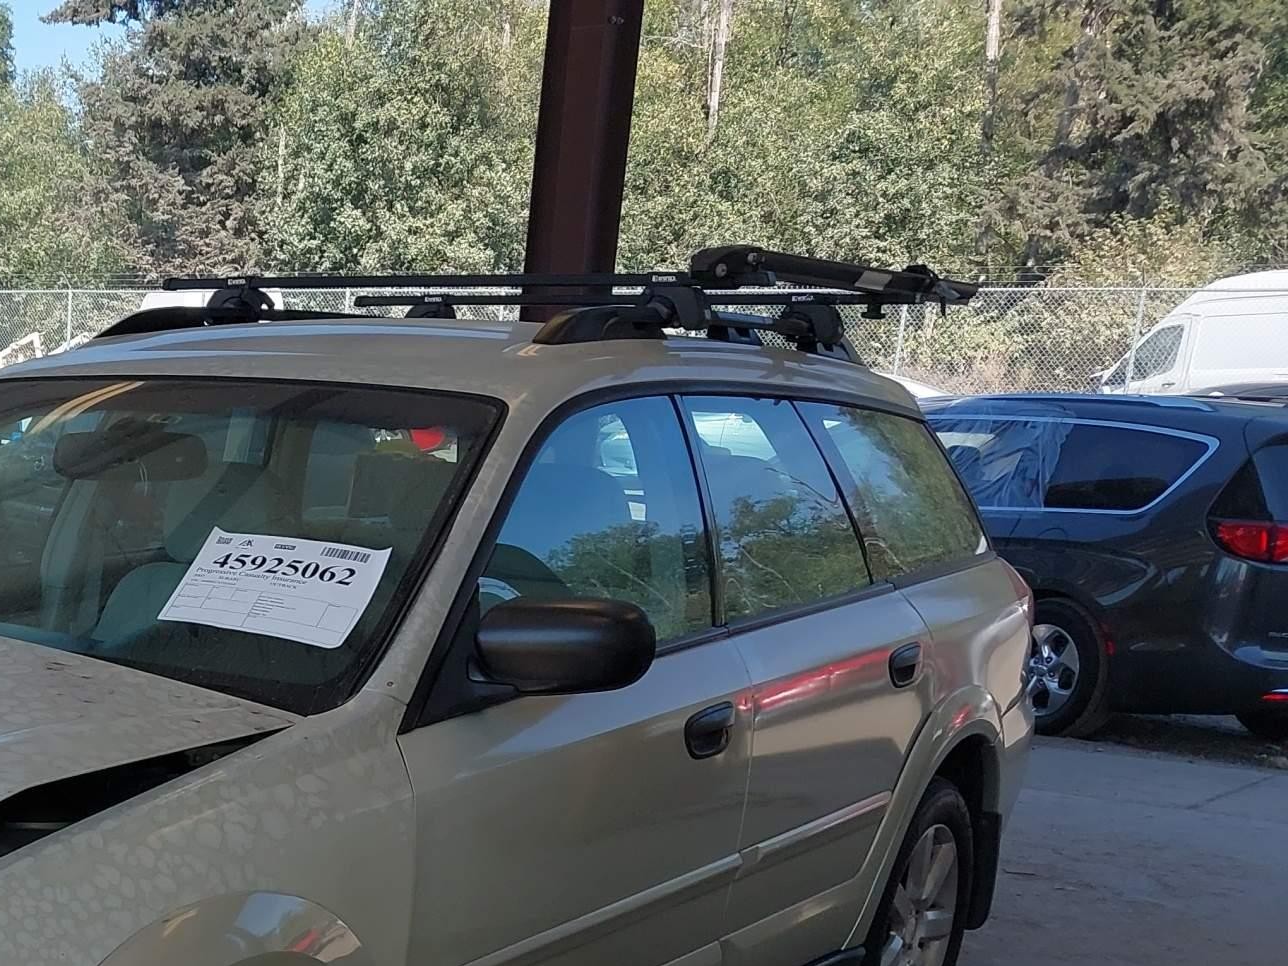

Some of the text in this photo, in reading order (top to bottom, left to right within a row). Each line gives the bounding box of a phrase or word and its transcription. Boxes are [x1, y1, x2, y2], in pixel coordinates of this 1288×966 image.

[196, 566, 238, 577] Progressive
[238, 571, 271, 581] Casualty
[271, 574, 308, 585] Insurance
[212, 552, 357, 586] 45925062
